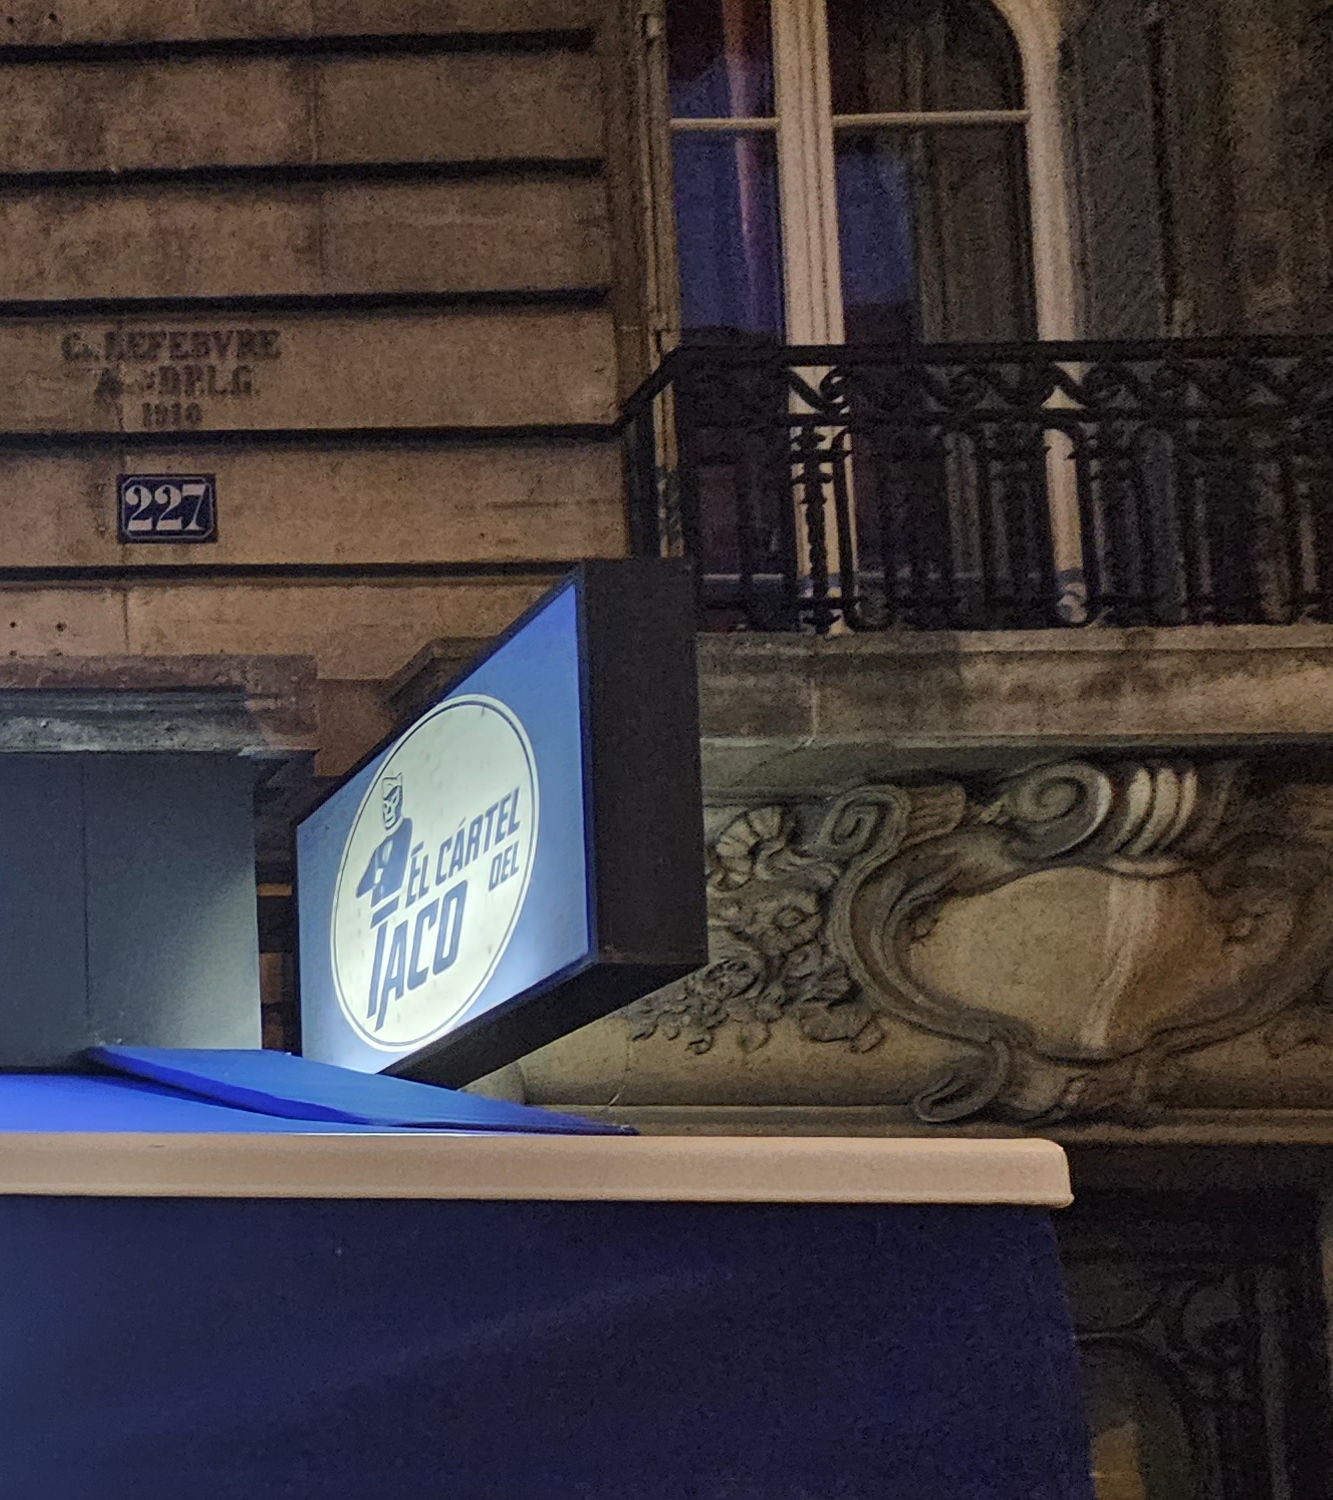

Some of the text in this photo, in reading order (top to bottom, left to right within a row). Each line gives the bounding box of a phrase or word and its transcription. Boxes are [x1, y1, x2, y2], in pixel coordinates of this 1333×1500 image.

[124, 483, 208, 532] 227
[405, 785, 521, 909] EL CÁRTEL
[488, 840, 520, 893] DEL
[366, 879, 469, 1033] TACO
